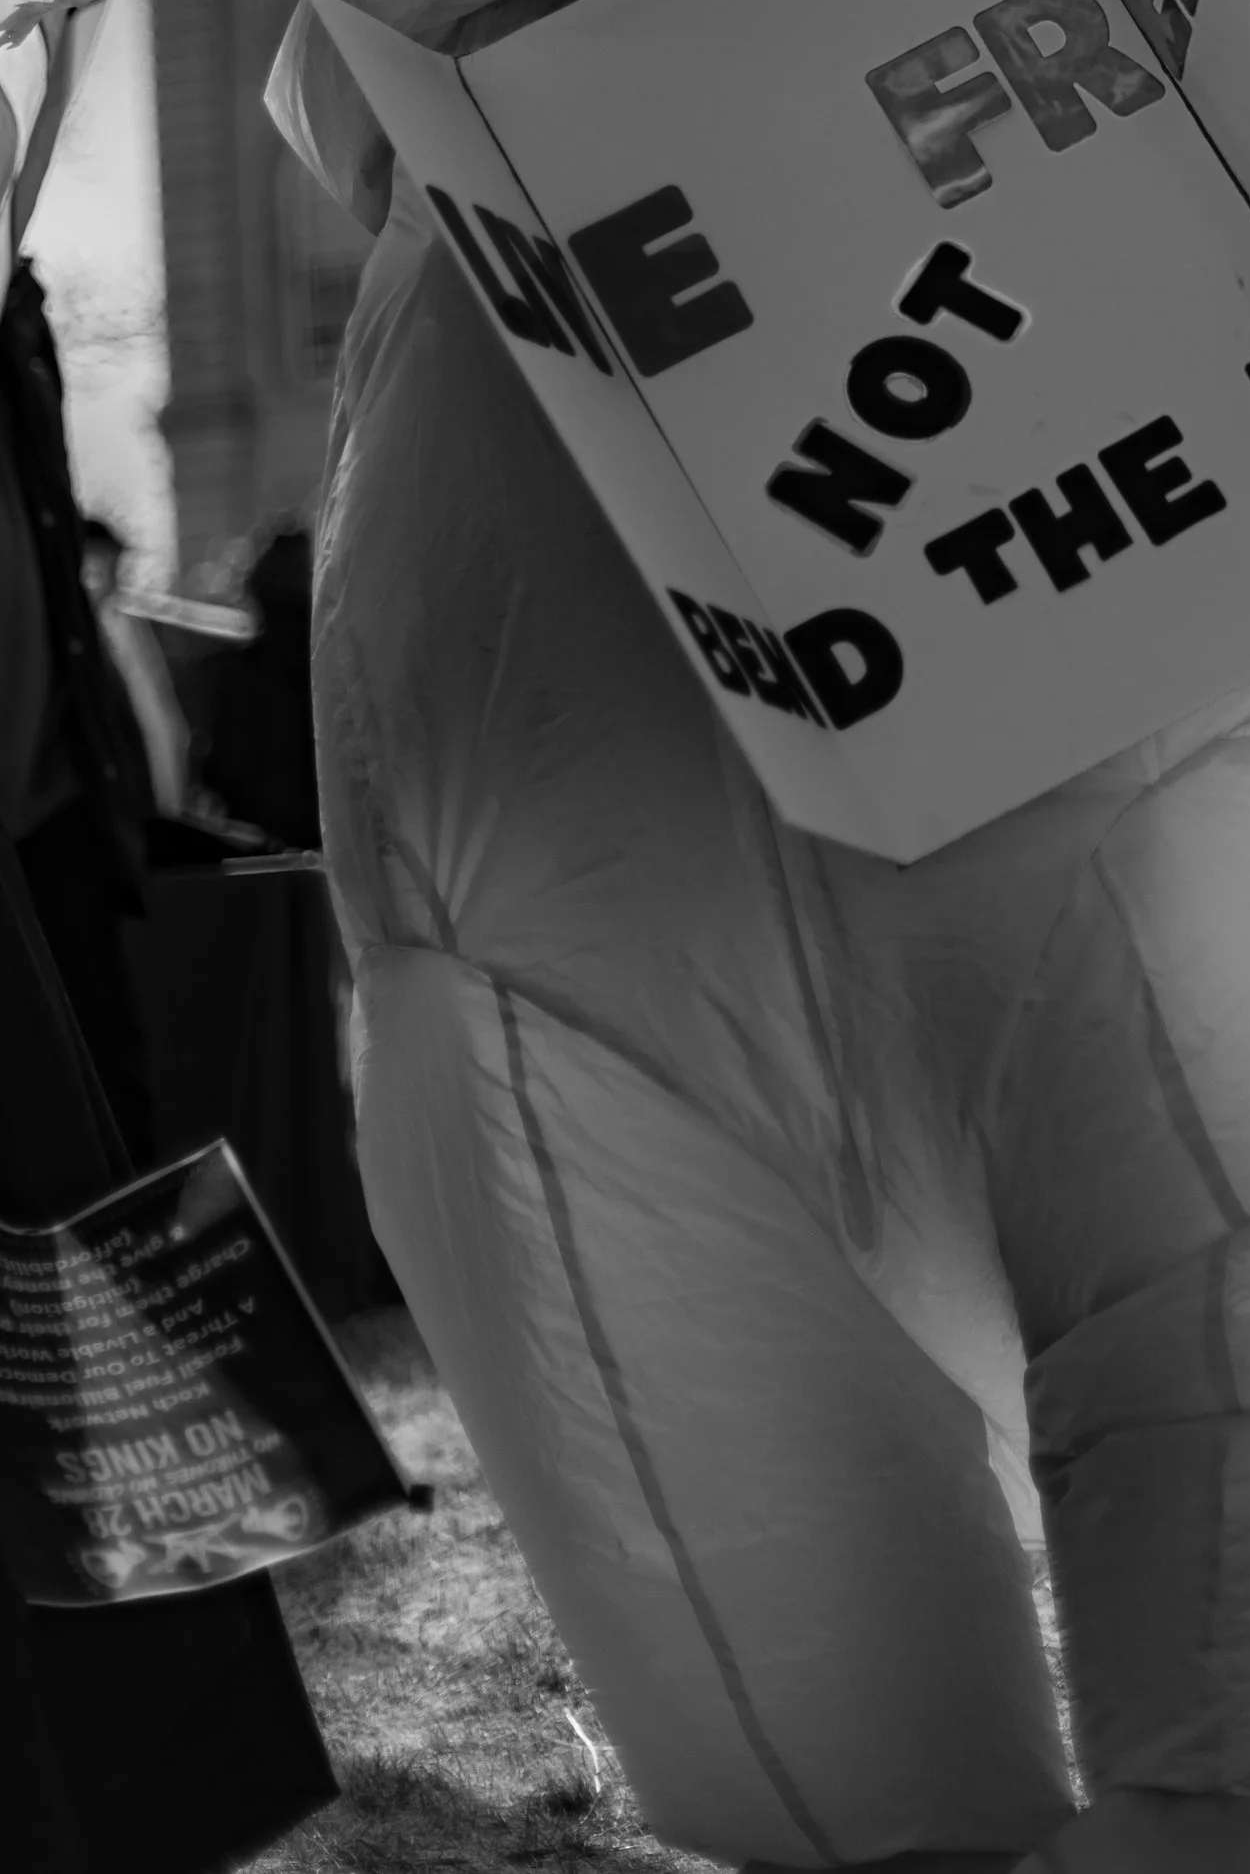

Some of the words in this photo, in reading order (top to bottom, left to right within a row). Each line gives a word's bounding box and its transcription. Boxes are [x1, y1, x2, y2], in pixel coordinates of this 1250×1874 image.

[426, 185, 753, 377] LIVE
[766, 240, 1024, 557] NOT
[665, 587, 904, 731] BEND
[924, 415, 1227, 606] THE
[119, 1233, 166, 1269] give
[175, 1237, 251, 1290] Charge
[115, 1285, 175, 1319] them
[161, 1297, 204, 1334] And
[236, 1294, 255, 1315] A
[77, 1312, 112, 1330] for
[143, 1323, 158, 1338] a
[160, 1310, 240, 1356] Threat
[56, 1331, 140, 1361] Livable
[130, 1351, 162, 1367] To
[176, 1332, 244, 1380] Fossil
[82, 1361, 126, 1379] Our
[122, 1369, 175, 1396] Fuel
[152, 1381, 210, 1412] Koch
[47, 1403, 149, 1433] Network
[184, 1409, 244, 1457] NO
[55, 1431, 180, 1484] KINGS
[133, 1463, 271, 1527] MARCH
